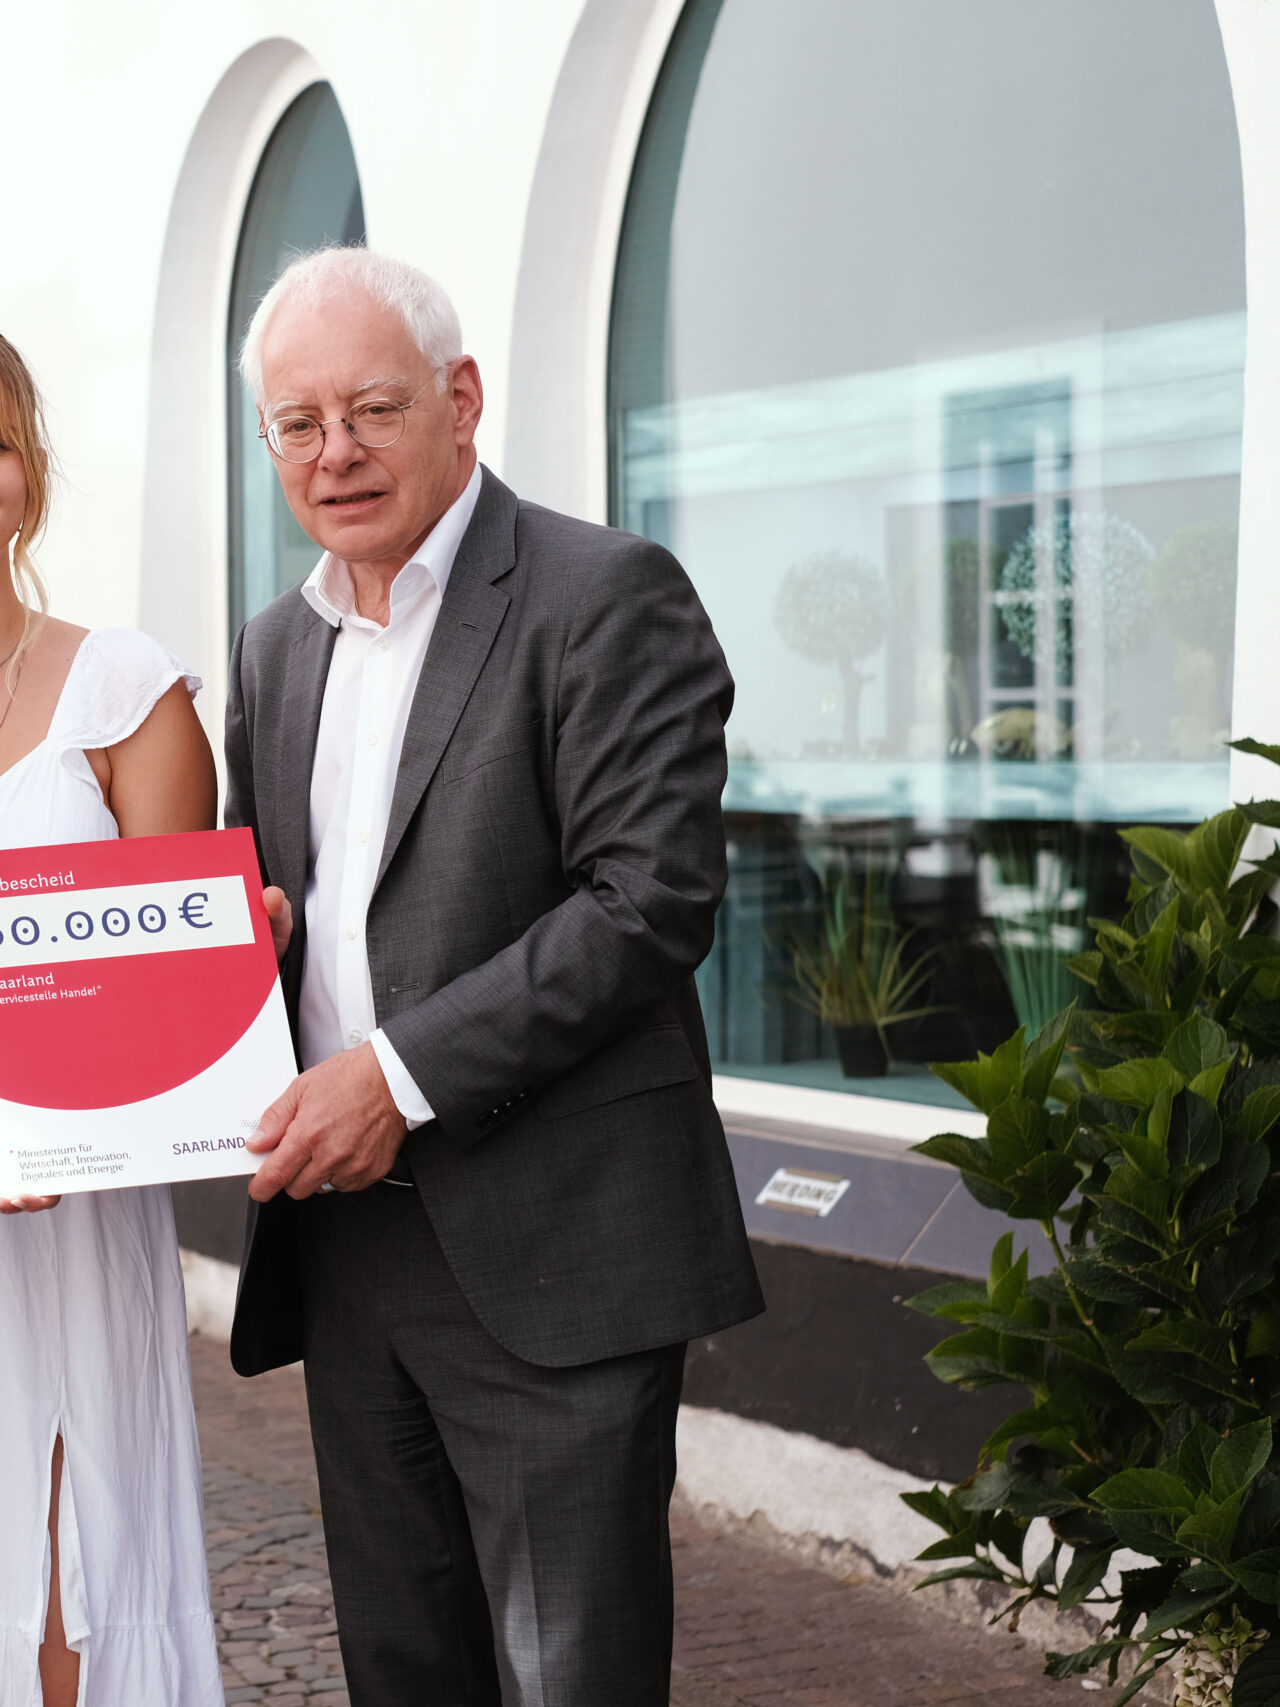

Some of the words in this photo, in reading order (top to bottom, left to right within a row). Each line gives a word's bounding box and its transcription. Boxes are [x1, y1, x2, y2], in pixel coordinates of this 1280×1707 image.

[18, 1145, 76, 1158] Ministerium
[79, 1143, 93, 1152] für
[173, 1136, 246, 1155] SAARLAND
[19, 1156, 75, 1170] Wirtschaft,
[76, 1152, 132, 1164] Innovation,
[21, 1168, 64, 1182] Digitales
[66, 1166, 85, 1176] und
[88, 1162, 124, 1175] Energie
